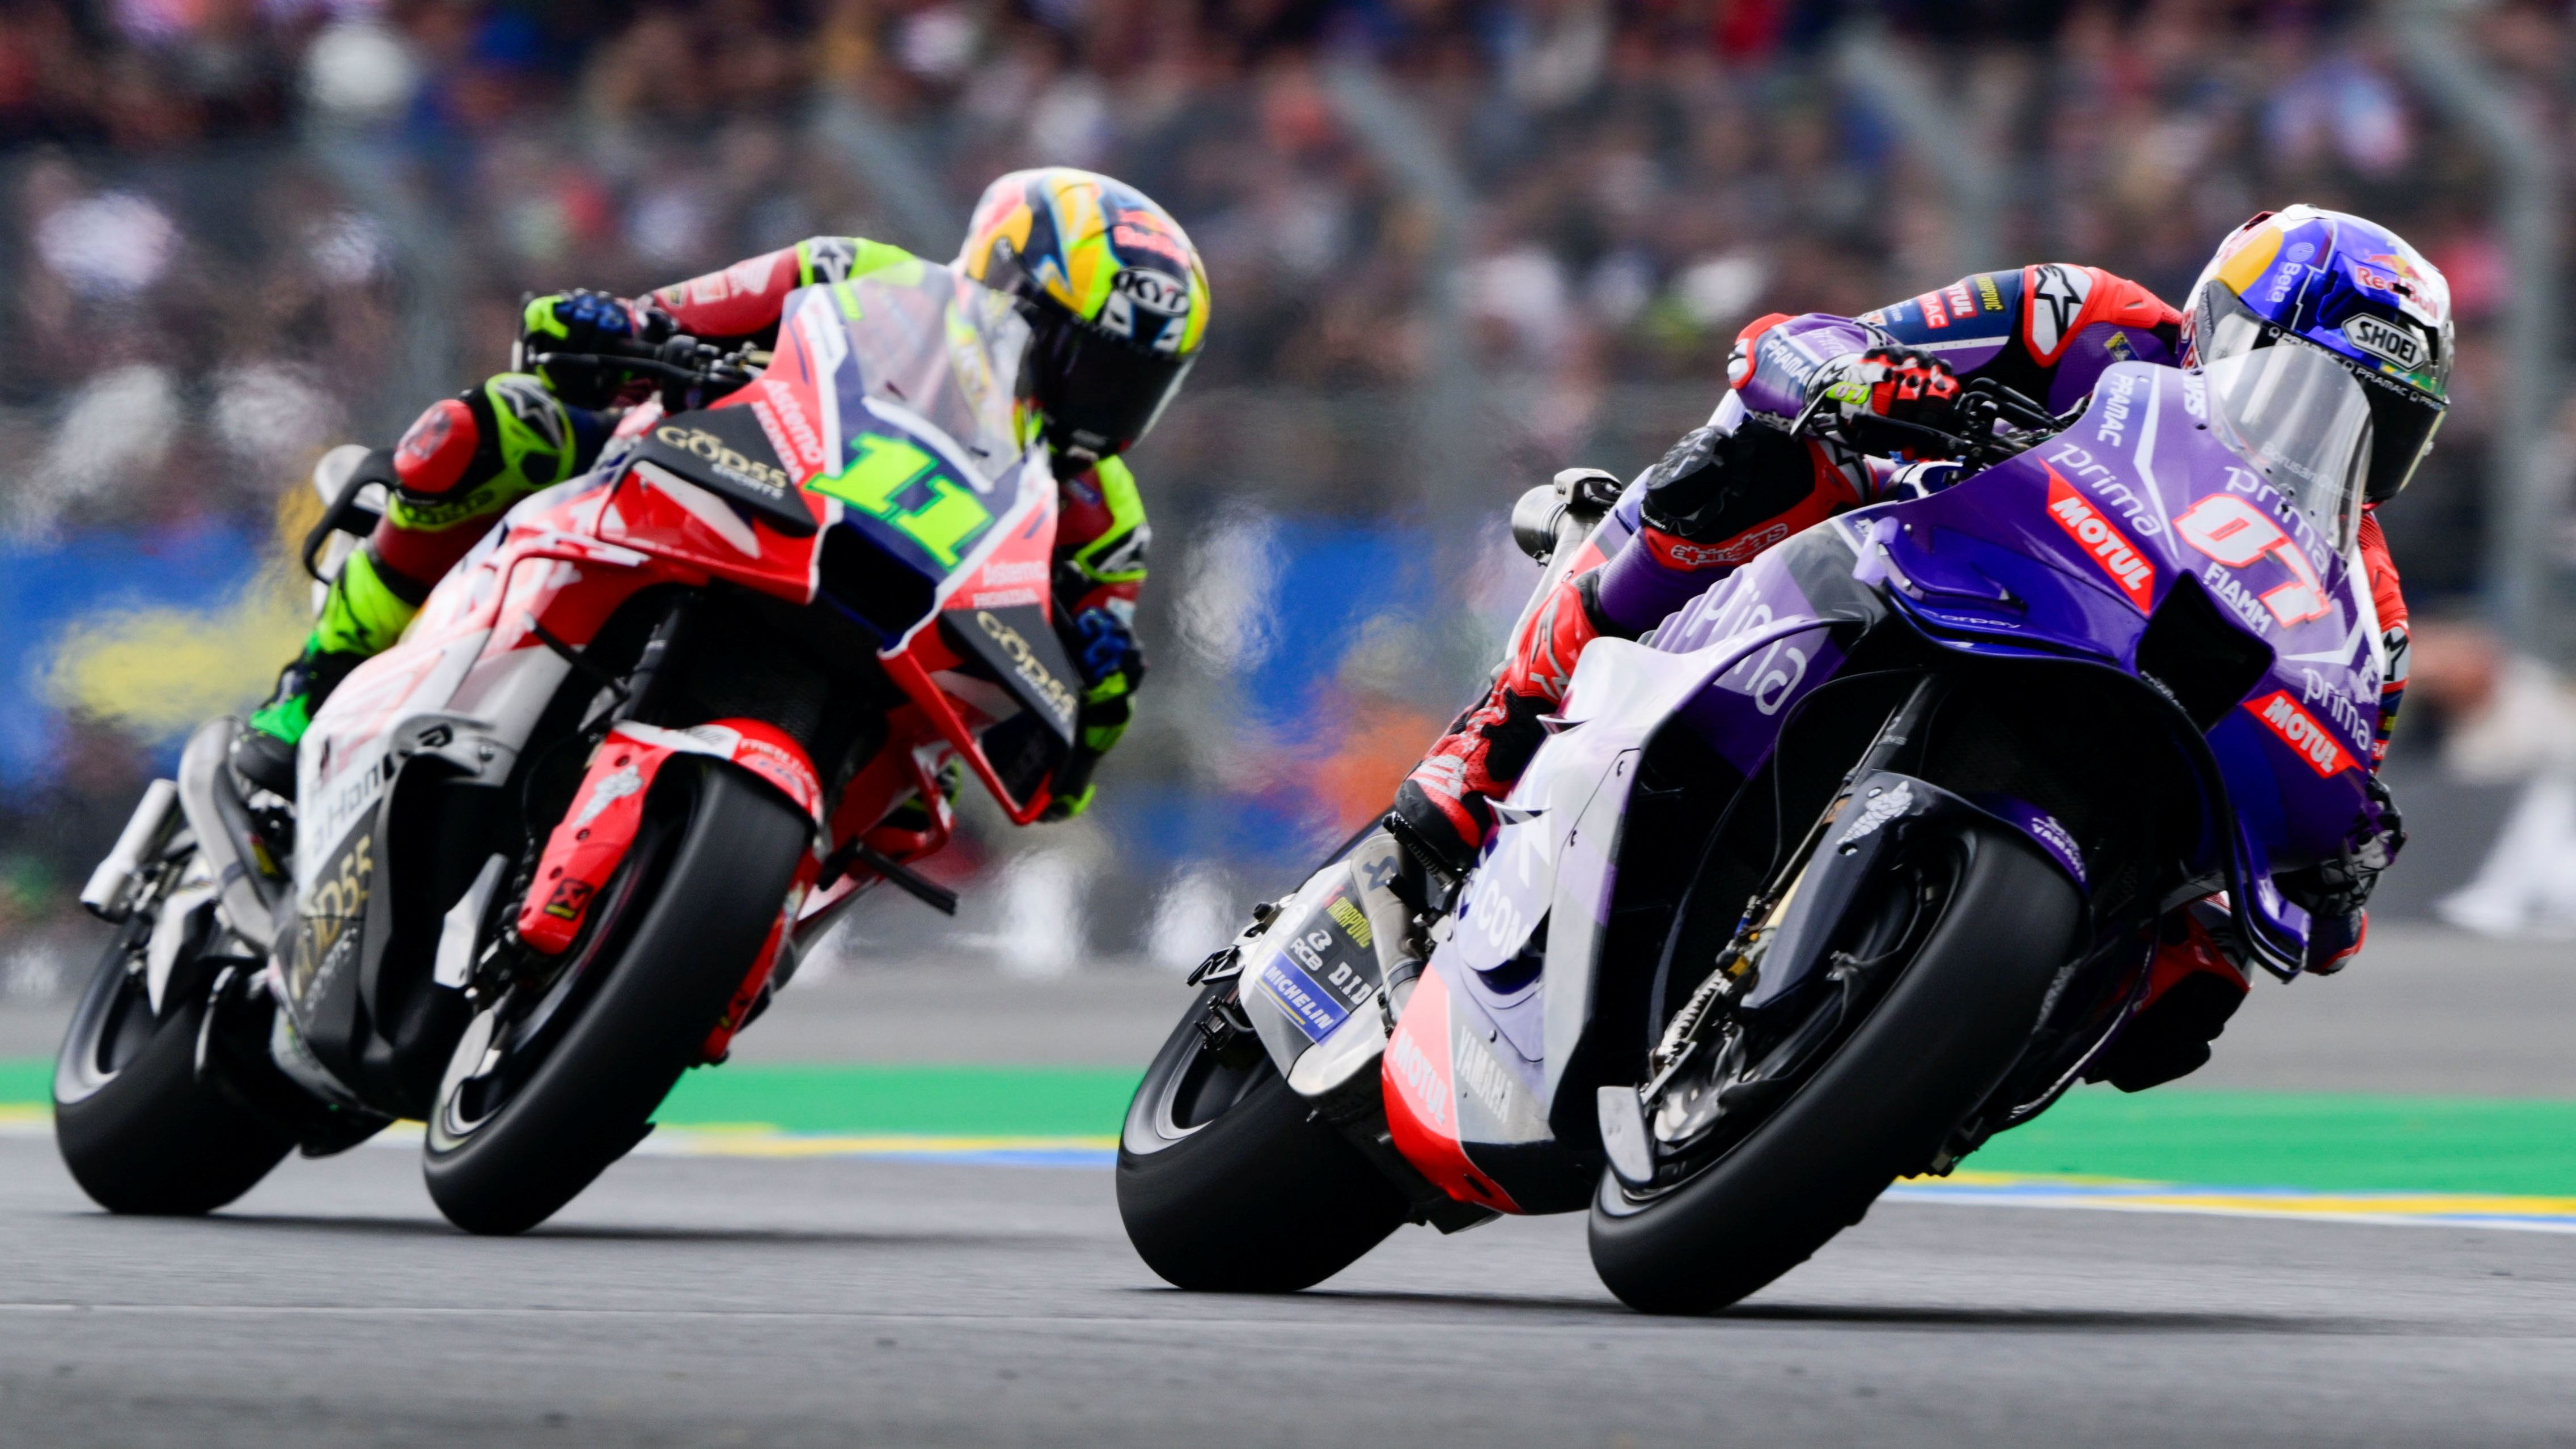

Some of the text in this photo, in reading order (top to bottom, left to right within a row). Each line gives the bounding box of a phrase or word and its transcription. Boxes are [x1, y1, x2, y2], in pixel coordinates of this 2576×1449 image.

[1112, 270, 1188, 311] KYT
[2266, 262, 2302, 303] Beta
[2355, 265, 2404, 295] Red
[2357, 320, 2417, 364] SHOEI
[2097, 372, 2135, 447] PRAMAC
[2182, 375, 2208, 420] WRS
[2355, 367, 2409, 397] PRAMAC
[751, 399, 804, 485] HONDA
[761, 379, 824, 465] Astemo
[2047, 443, 2164, 537] prima
[2261, 441, 2316, 482] Borusan
[803, 433, 995, 573] 11
[2223, 465, 2329, 574] prima
[2050, 497, 2152, 591] MOTUL
[2172, 493, 2333, 629] 07
[2203, 561, 2273, 634] FIAMM
[2262, 694, 2338, 773] MOTUL
[2302, 668, 2370, 751] prima
[1290, 937, 1323, 971] RCB
[1328, 961, 1372, 1005] D.I.D
[1264, 967, 1333, 1029] MICHELIN
[1392, 1027, 1448, 1125] MOTUL
[1456, 1024, 1513, 1124] YAMAHA
